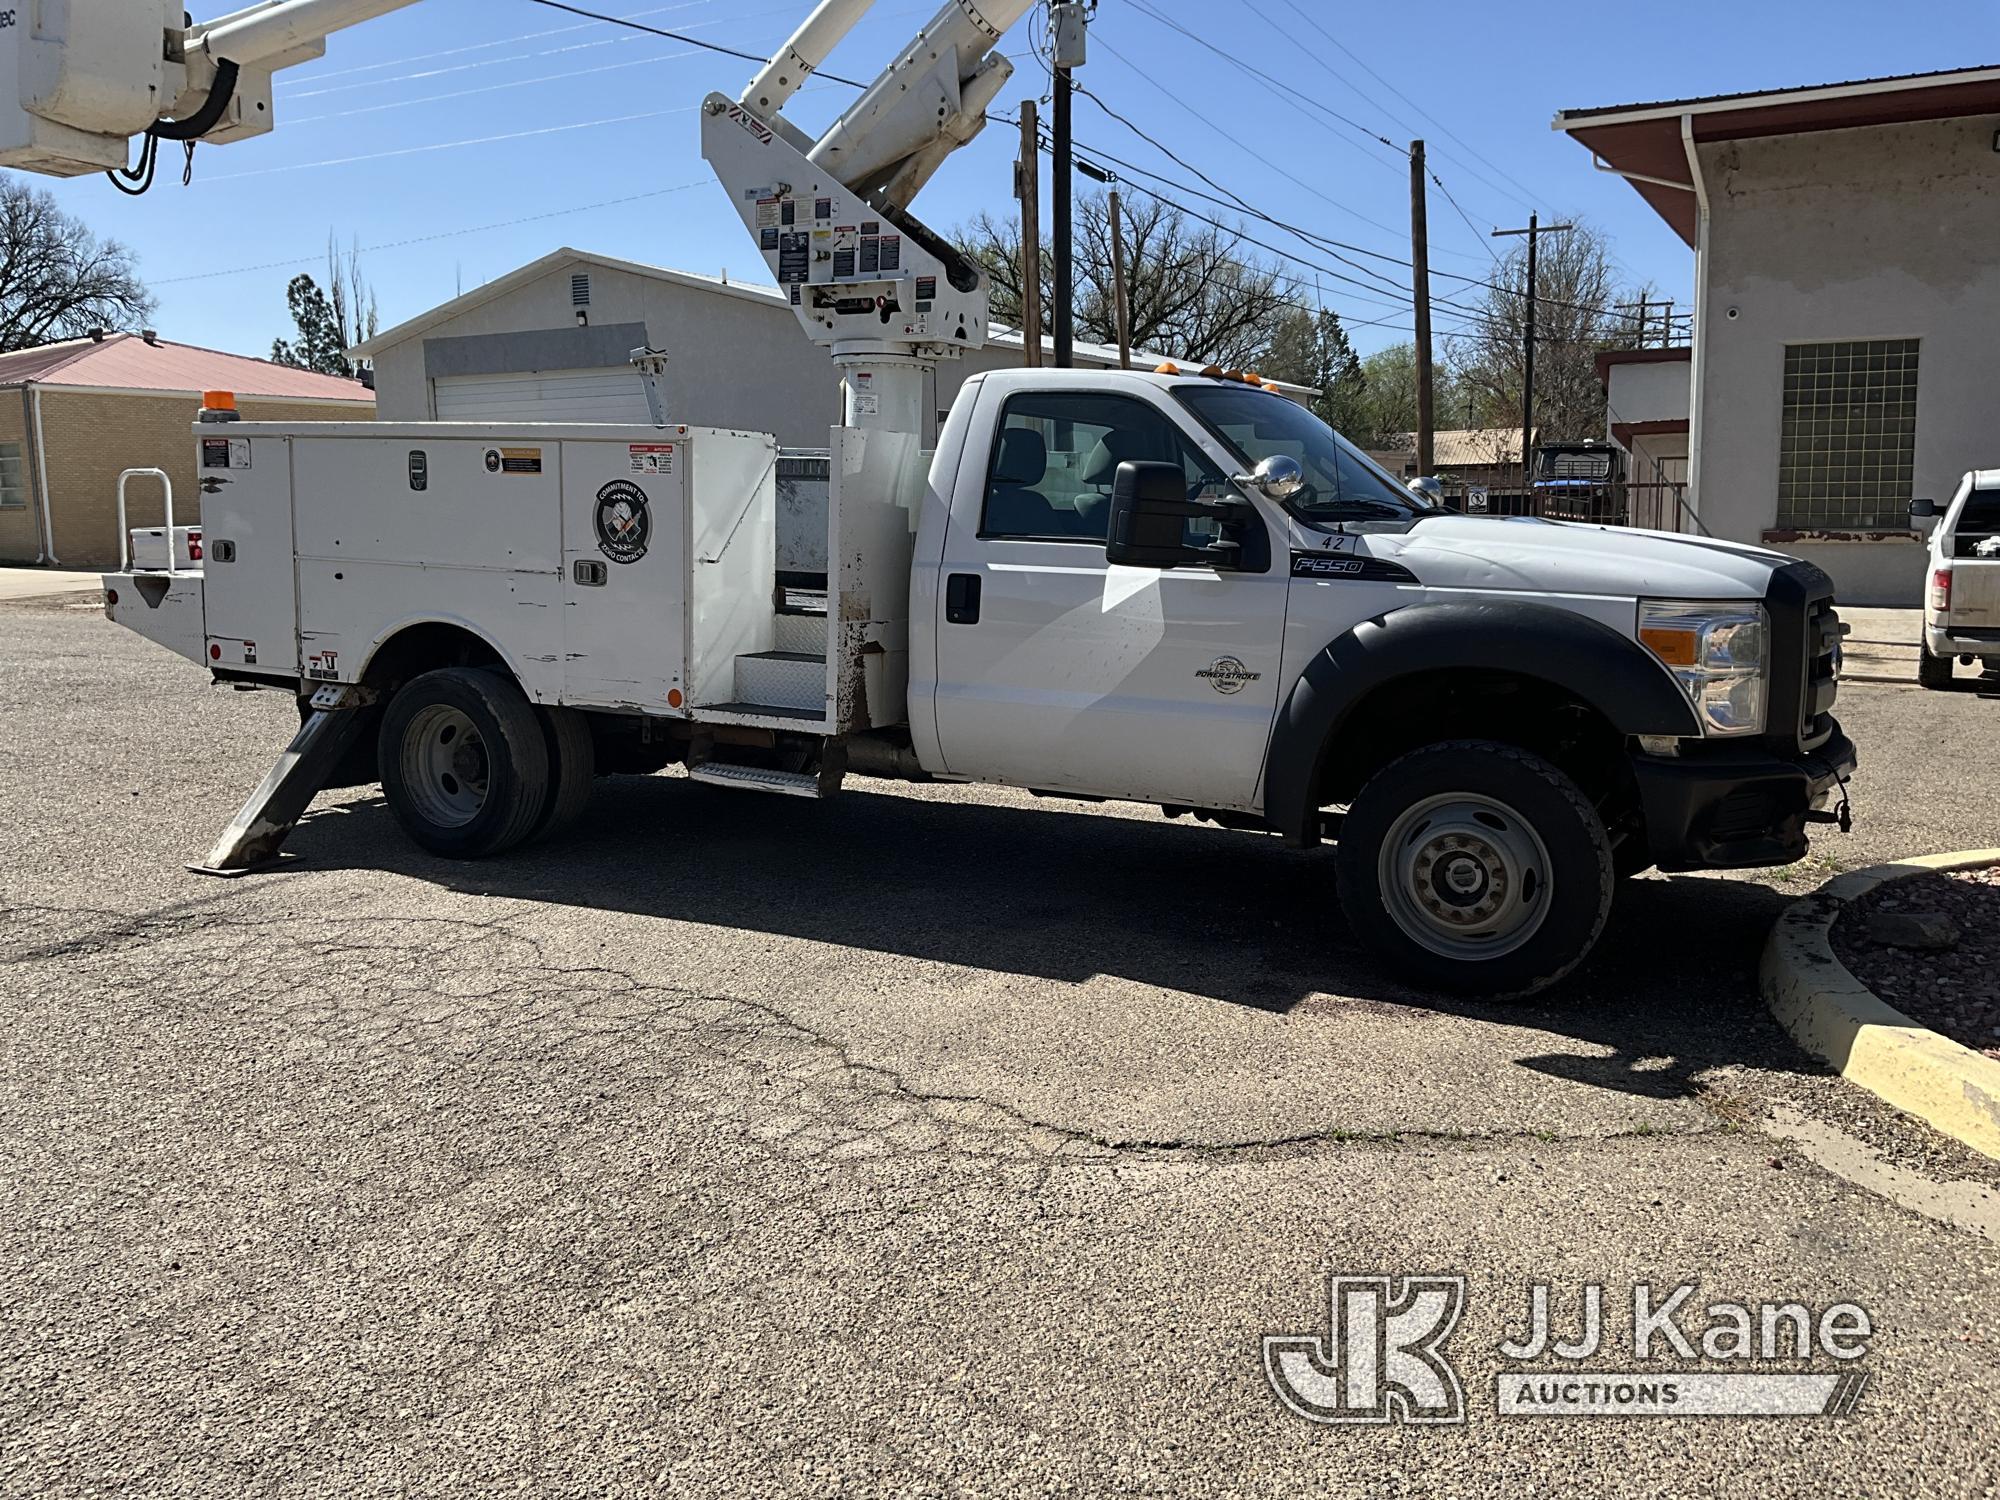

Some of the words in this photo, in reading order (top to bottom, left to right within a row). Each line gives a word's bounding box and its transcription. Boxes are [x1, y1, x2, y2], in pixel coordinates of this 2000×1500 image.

[0, 9, 16, 28] ec
[599, 482, 637, 500] COMMITMENT
[1322, 536, 1344, 550] 42
[616, 547, 645, 562] CONTACTS
[1294, 558, 1364, 574] F-550
[1195, 671, 1224, 679] POWER
